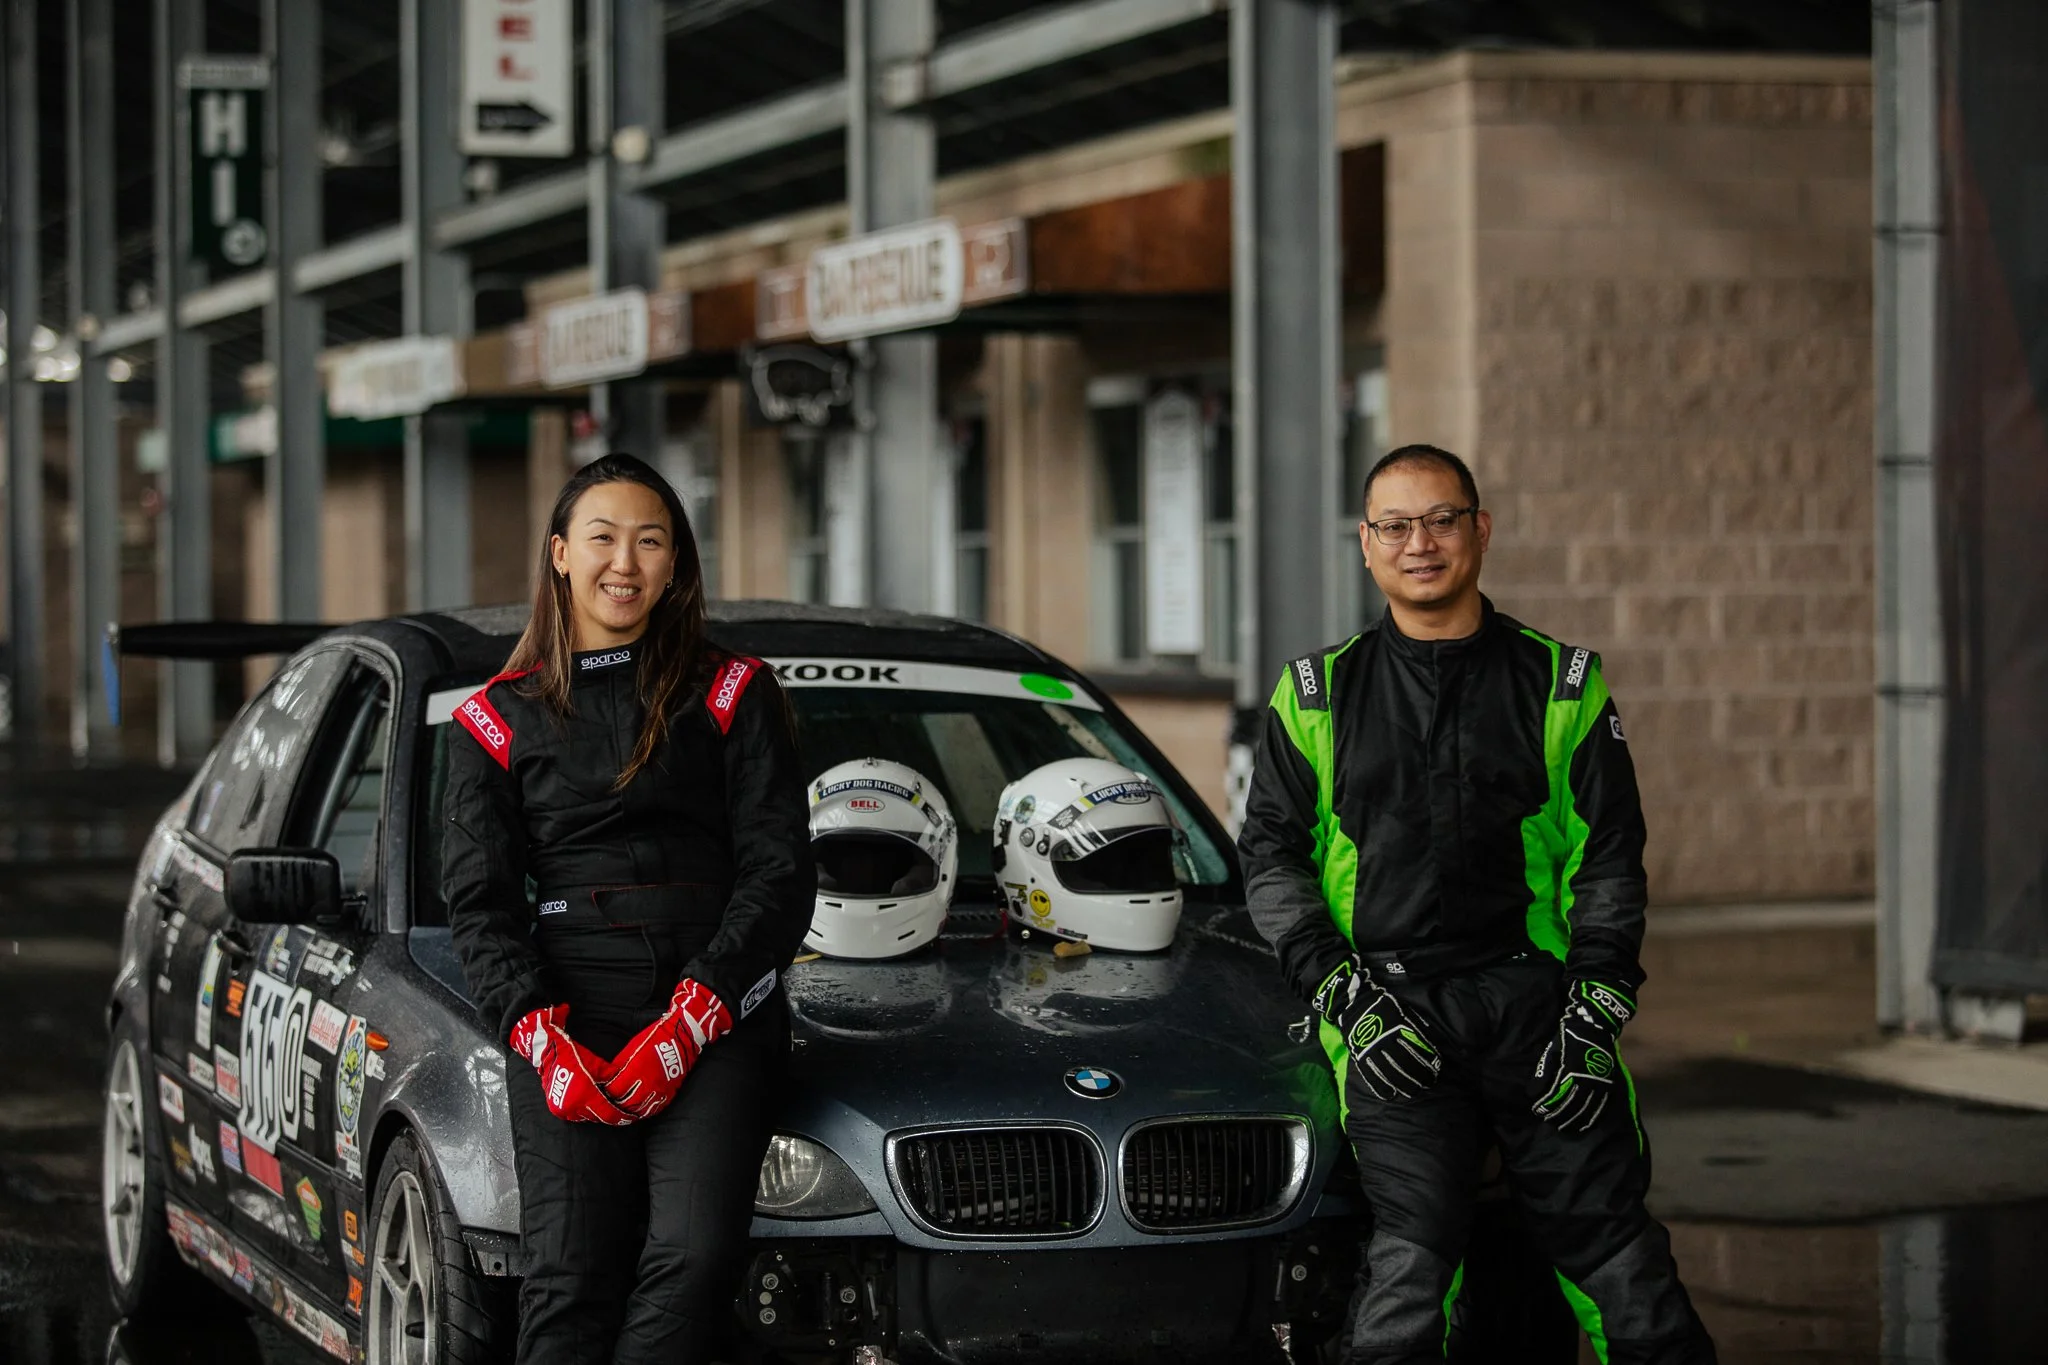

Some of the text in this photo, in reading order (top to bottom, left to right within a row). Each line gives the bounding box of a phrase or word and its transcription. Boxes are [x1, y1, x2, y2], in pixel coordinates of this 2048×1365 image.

[581, 649, 631, 669] sparco
[716, 662, 748, 711] sparco
[461, 699, 505, 749] sparco
[822, 781, 852, 797] LUCKY
[853, 779, 873, 788] DOG
[1092, 784, 1124, 802] LUCKY
[850, 800, 880, 808] BELL
[656, 1039, 683, 1081] OMP
[549, 1065, 574, 1109] OMP
